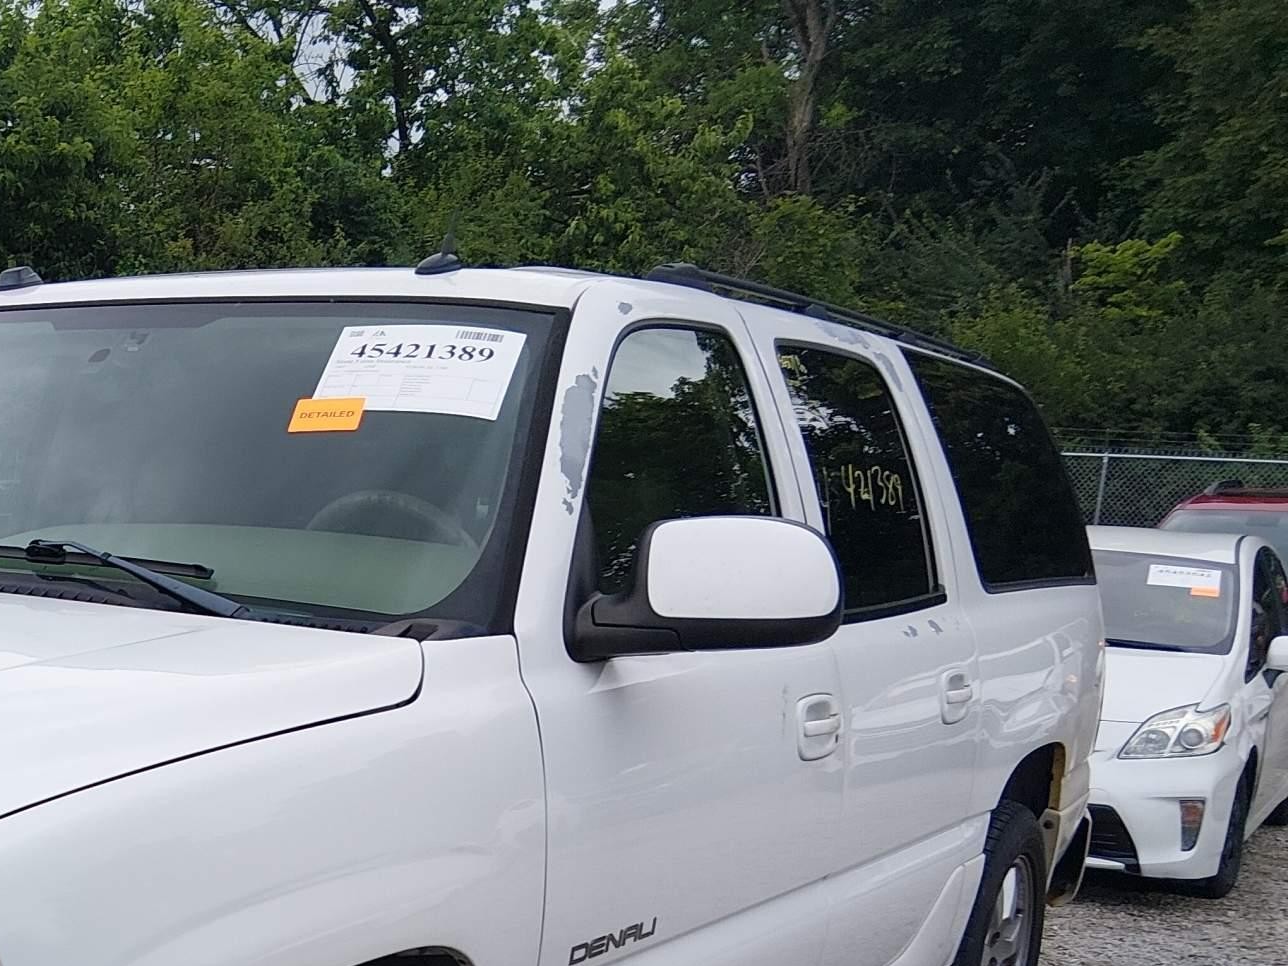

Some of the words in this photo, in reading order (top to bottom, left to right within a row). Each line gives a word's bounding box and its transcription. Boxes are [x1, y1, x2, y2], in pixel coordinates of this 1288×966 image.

[350, 343, 495, 363] 45421389
[299, 410, 354, 419] DETAILED
[568, 916, 657, 966] DENALI
